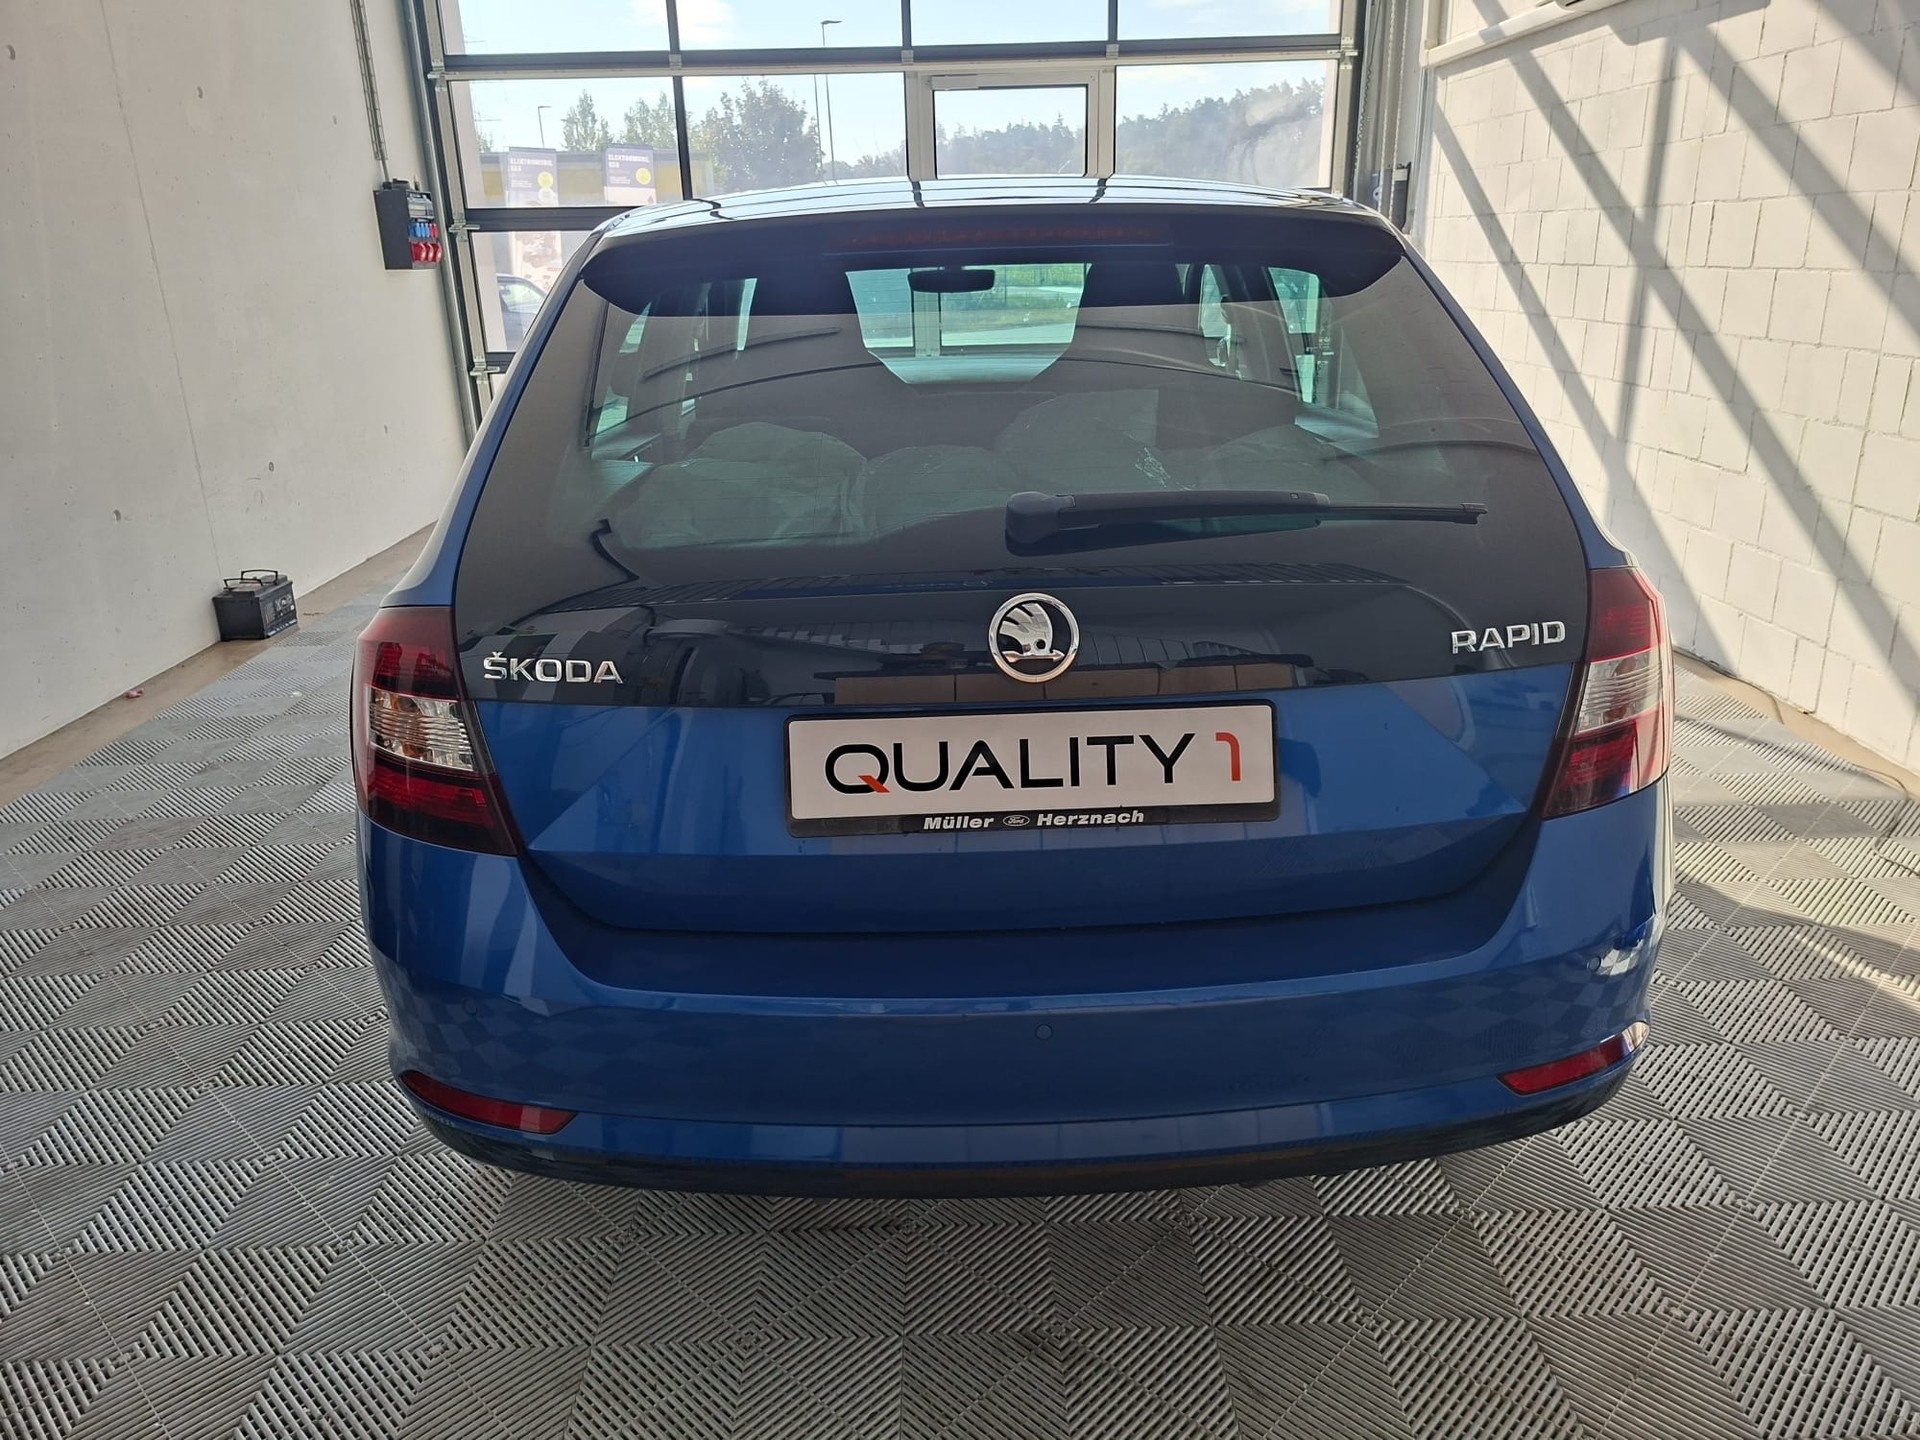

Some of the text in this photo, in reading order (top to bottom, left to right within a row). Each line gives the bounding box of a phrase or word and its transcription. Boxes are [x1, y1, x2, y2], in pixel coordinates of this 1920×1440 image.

[1451, 620, 1566, 654] RAPID
[483, 651, 624, 684] ŠKODA
[923, 810, 1145, 830] Müller Ford Herznach
